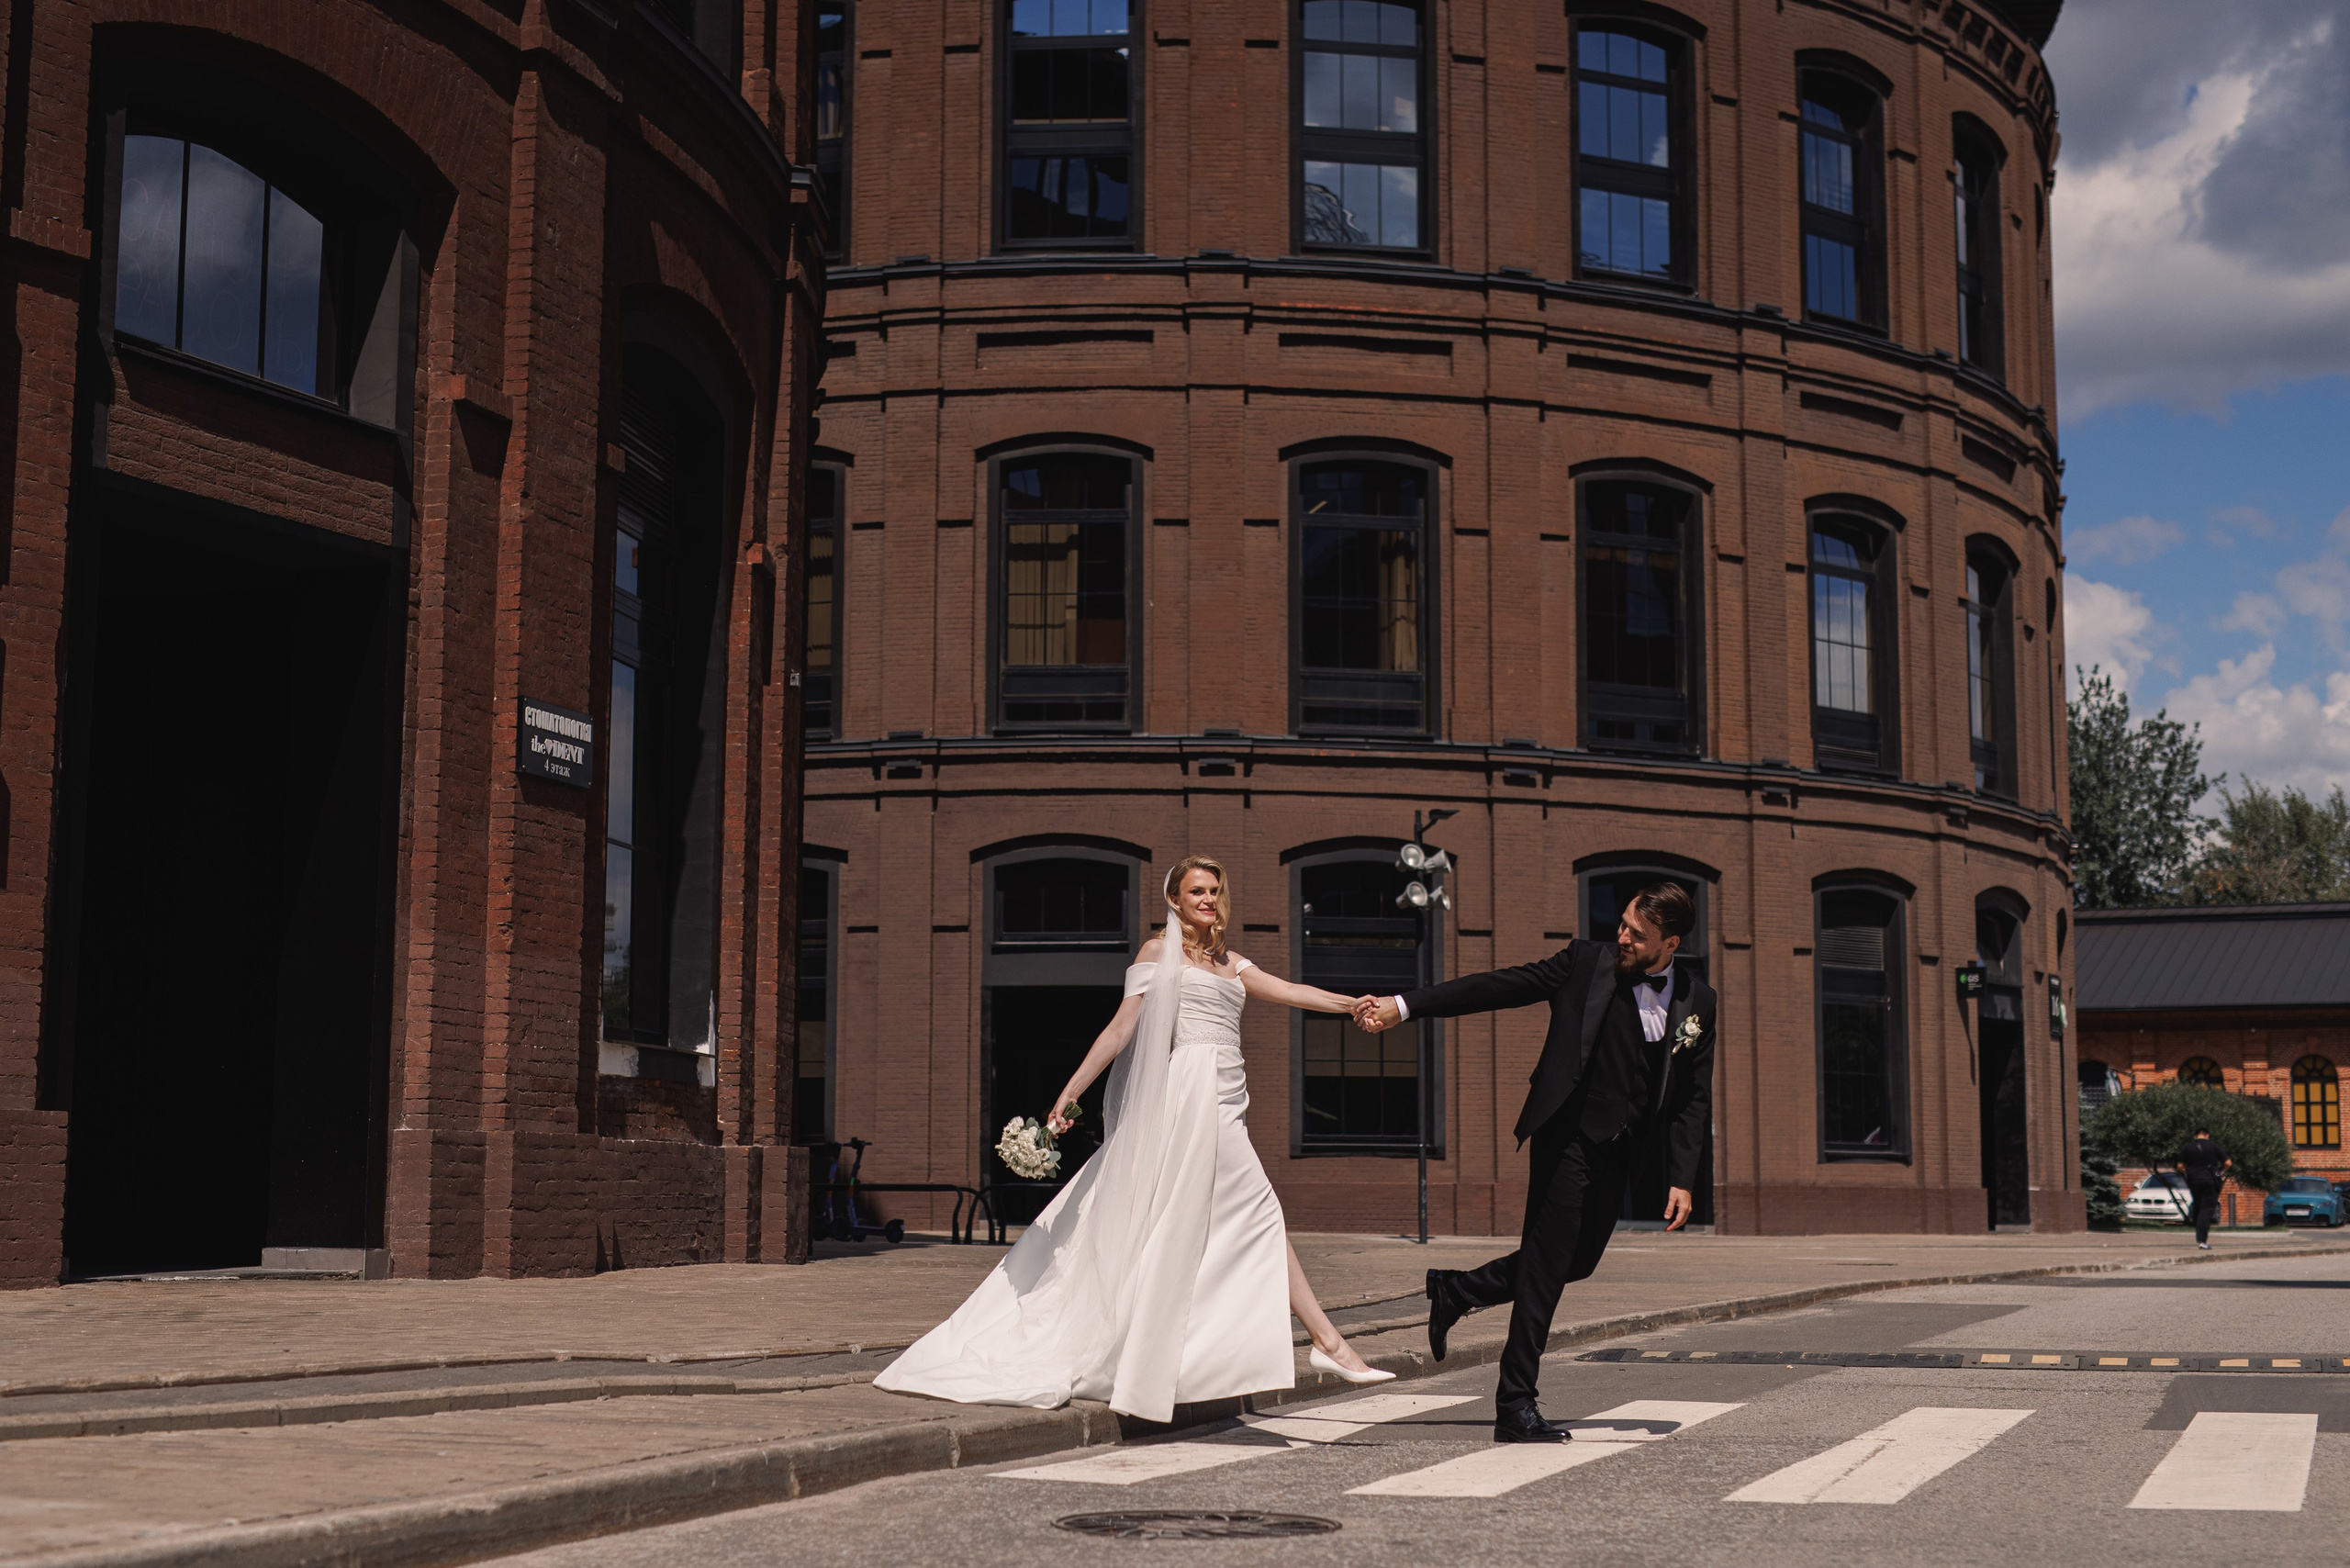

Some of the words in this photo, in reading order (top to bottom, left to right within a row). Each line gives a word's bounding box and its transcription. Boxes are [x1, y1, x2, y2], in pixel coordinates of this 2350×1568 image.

[525, 706, 592, 743] СТОМАТОЛОГИЯ
[544, 759, 549, 771] 4
[551, 763, 570, 778] этаж
